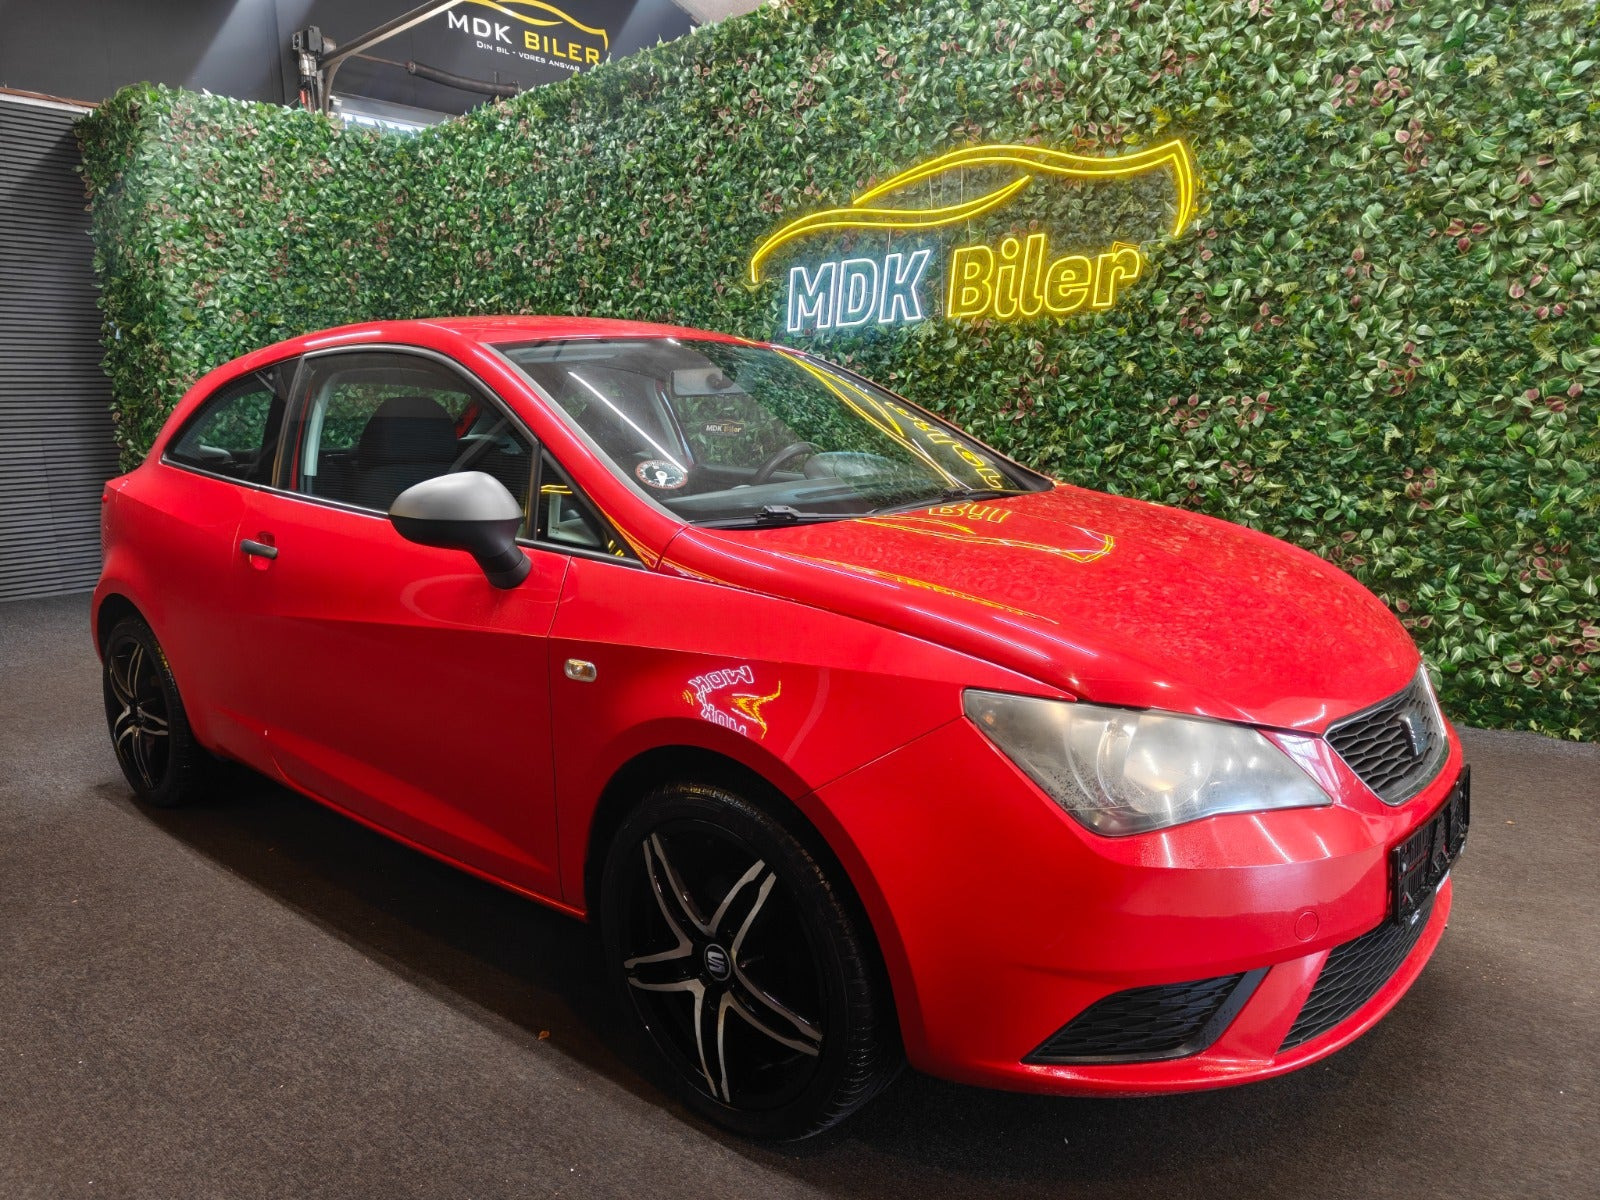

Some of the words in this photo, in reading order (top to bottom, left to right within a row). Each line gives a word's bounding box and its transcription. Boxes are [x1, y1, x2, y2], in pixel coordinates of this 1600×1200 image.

[447, 10, 513, 45] MDK
[524, 30, 601, 66] BILER
[518, 52, 546, 64] VORES
[548, 60, 580, 72] ANSVAR
[786, 249, 932, 333] MDK
[947, 233, 1142, 319] Biler
